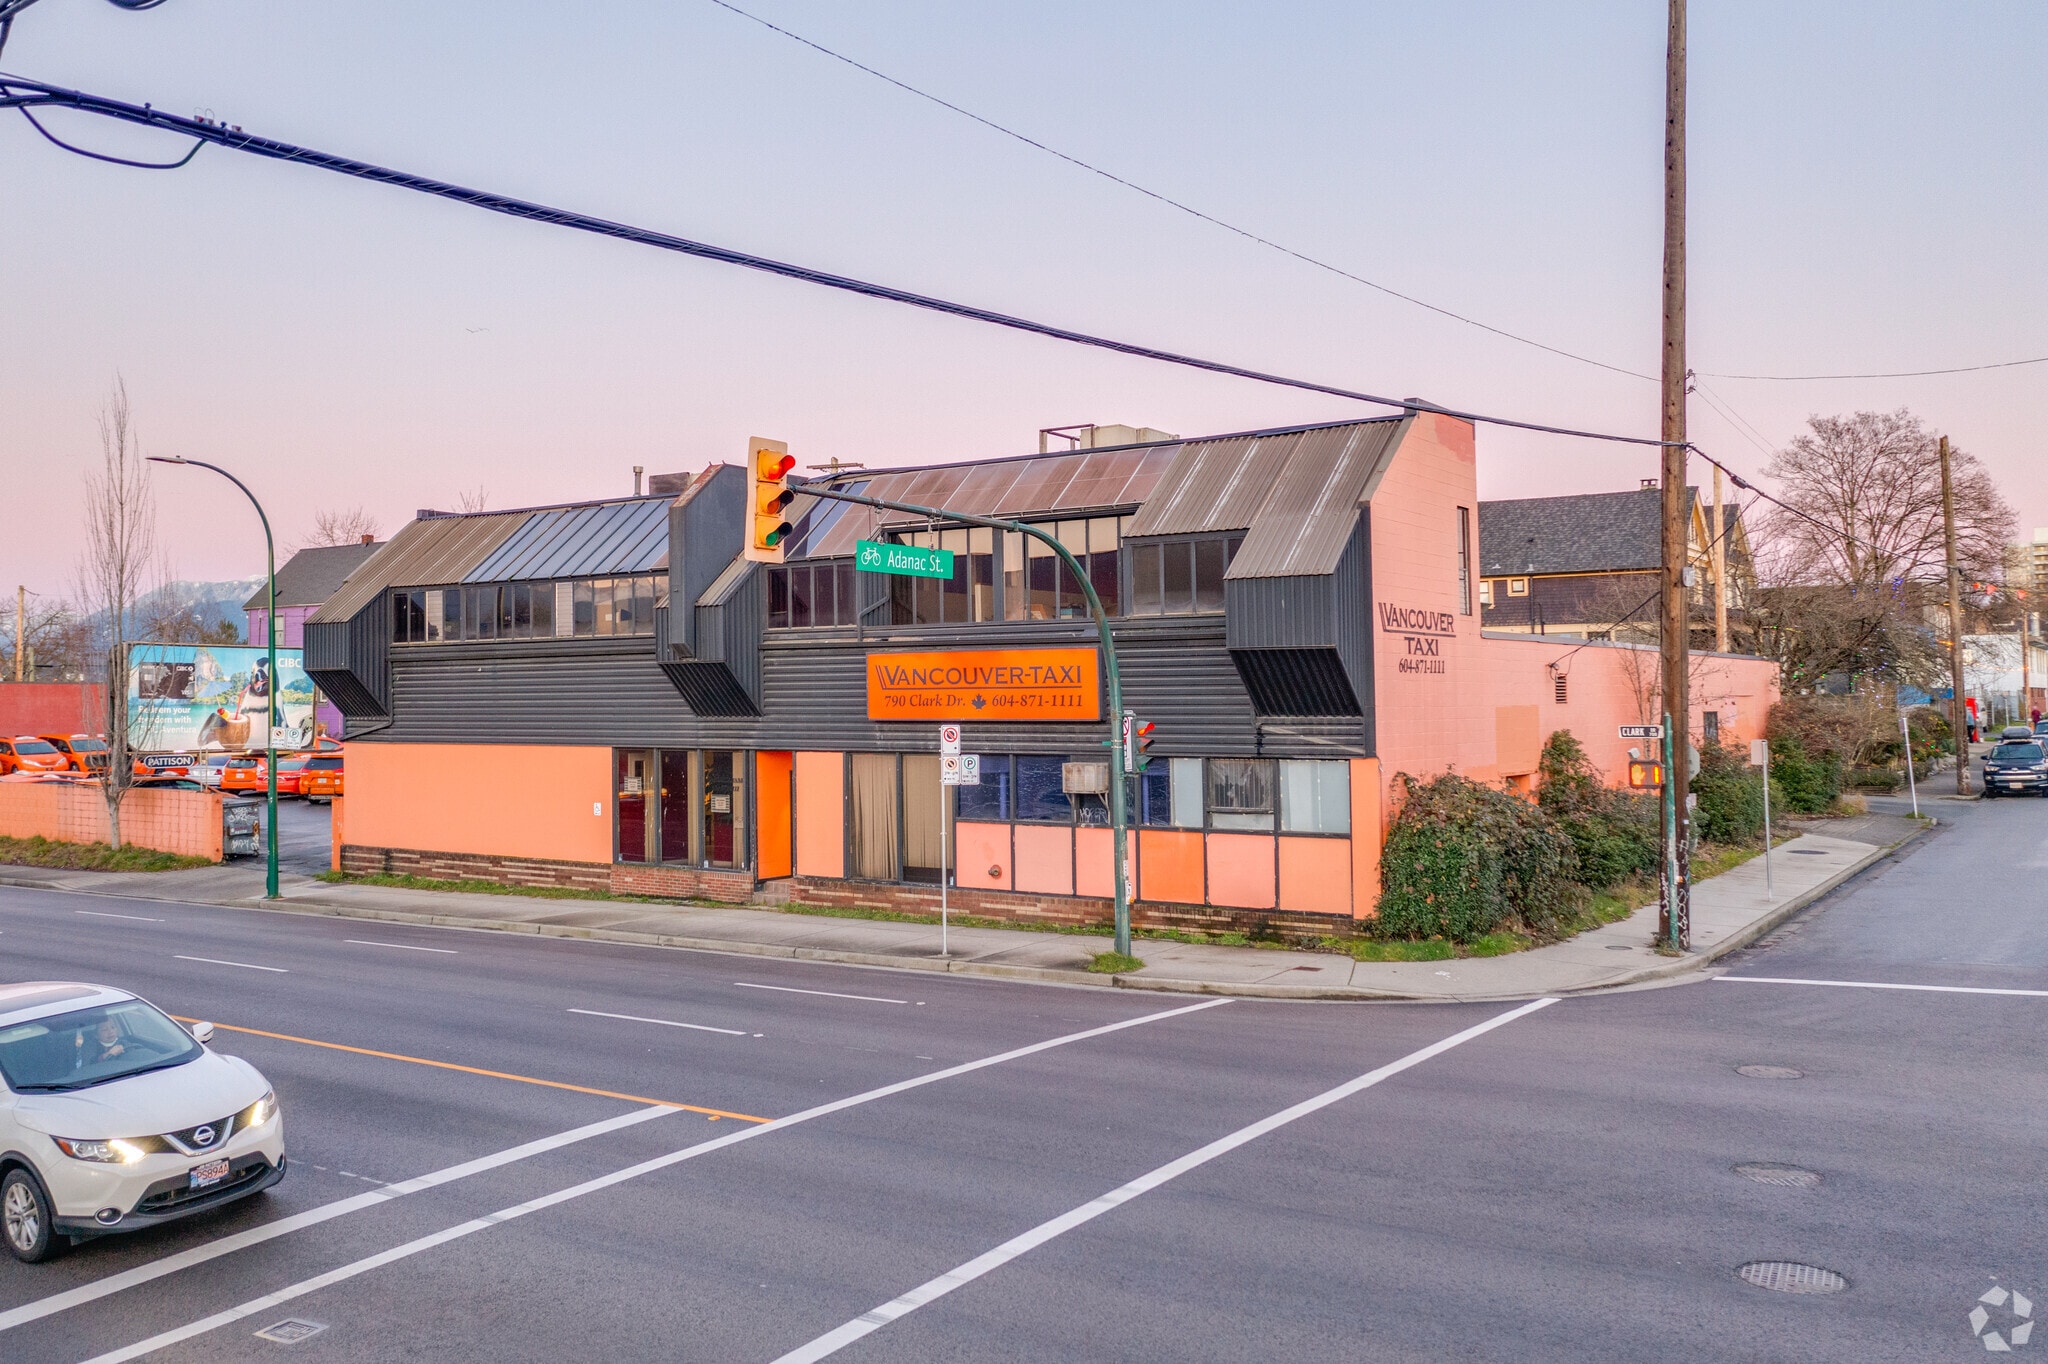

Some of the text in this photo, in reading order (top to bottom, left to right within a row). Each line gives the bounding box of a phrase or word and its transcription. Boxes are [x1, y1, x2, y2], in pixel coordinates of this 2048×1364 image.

[887, 550, 944, 573] Adanac St.
[1383, 602, 1454, 633] VANCOUVER
[1404, 636, 1439, 656] TAXI
[278, 658, 302, 668] CIBC
[1398, 658, 1445, 674] 604-871-1111
[884, 664, 1082, 686] VANCOUVER-TAXI
[885, 693, 966, 708] 790 Clark Dr.
[992, 694, 1083, 708] 604-871-1111
[174, 706, 191, 716] your
[174, 715, 191, 723] with
[1622, 727, 1645, 736] CLARK
[147, 757, 191, 766] PATTISON
